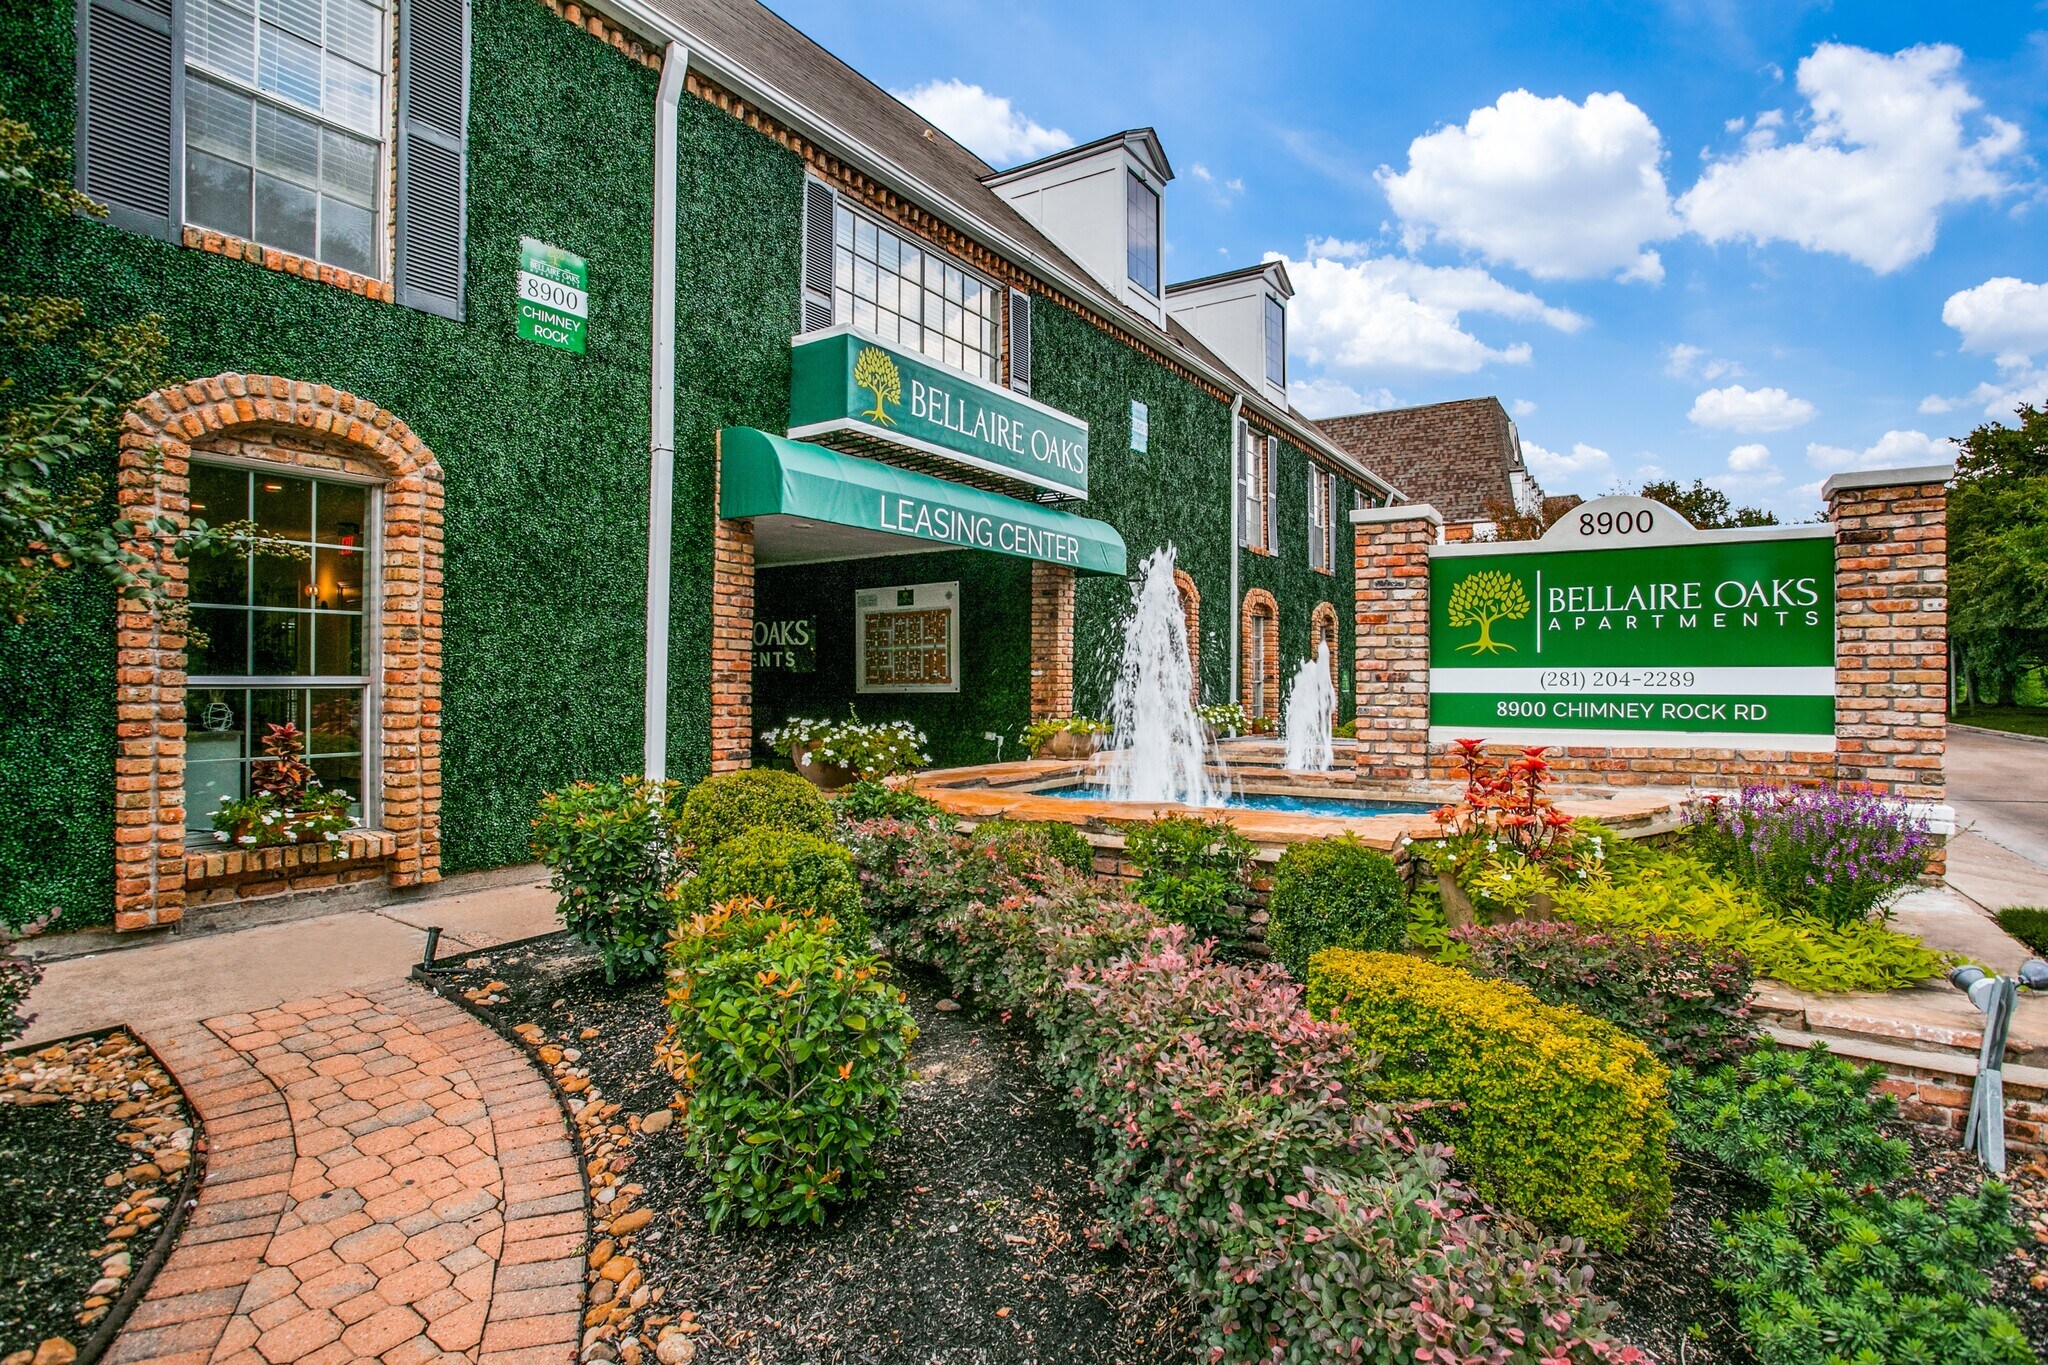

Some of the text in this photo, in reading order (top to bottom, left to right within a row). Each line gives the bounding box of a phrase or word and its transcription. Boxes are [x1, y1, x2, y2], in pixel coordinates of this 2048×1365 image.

[530, 260, 580, 284] BELLAIRE OAKS
[527, 278, 578, 310] 8900
[522, 305, 581, 331] CHIMNEY
[534, 324, 569, 345] ROCK
[911, 379, 1084, 474] BELLAIRE OAKS
[880, 495, 1079, 563] LEASING CENTER
[1579, 510, 1654, 536] 8900
[1548, 578, 1818, 613] BELLAIRE OAKS
[752, 620, 809, 646] OAKS
[1548, 611, 1819, 631] APARTMENTS
[1540, 671, 1695, 691] (281) 204-2289
[1496, 700, 1767, 721] 8900 CHIMNEY ROCK RD
